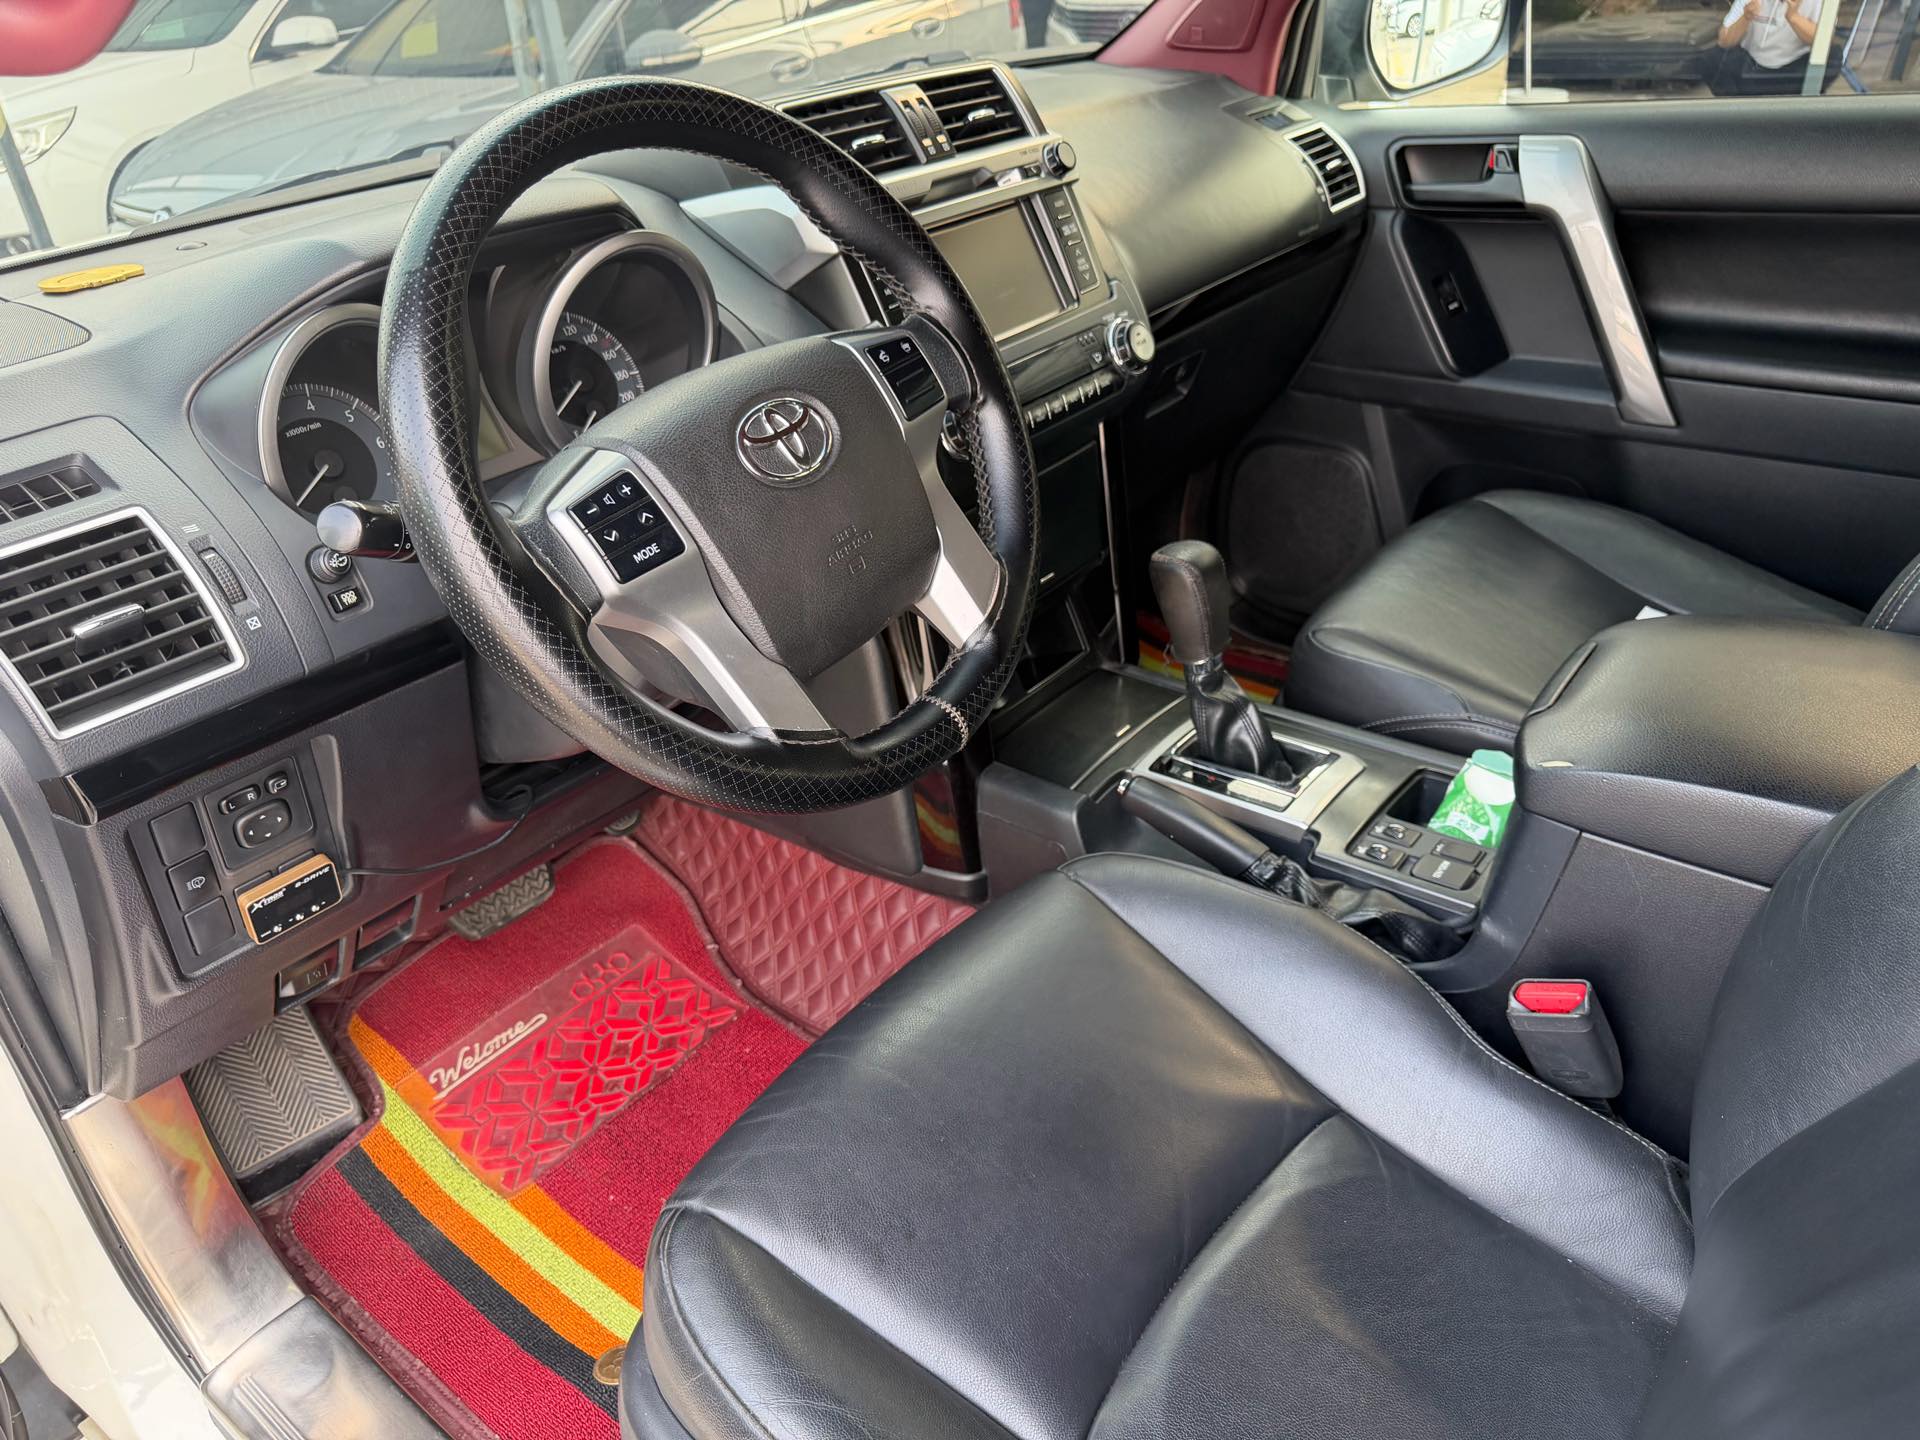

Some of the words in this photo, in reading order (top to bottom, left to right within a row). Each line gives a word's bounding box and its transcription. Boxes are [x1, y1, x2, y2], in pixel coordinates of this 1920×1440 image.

[562, 324, 578, 337] 120
[583, 333, 598, 346] 140
[602, 350, 617, 361] 160
[614, 369, 630, 382] 180
[619, 390, 635, 404] 200
[306, 399, 316, 412] 4
[344, 409, 355, 423] 5
[376, 436, 386, 449] 6
[632, 542, 661, 564] MODE
[229, 802, 236, 810] L
[247, 792, 256, 801] R
